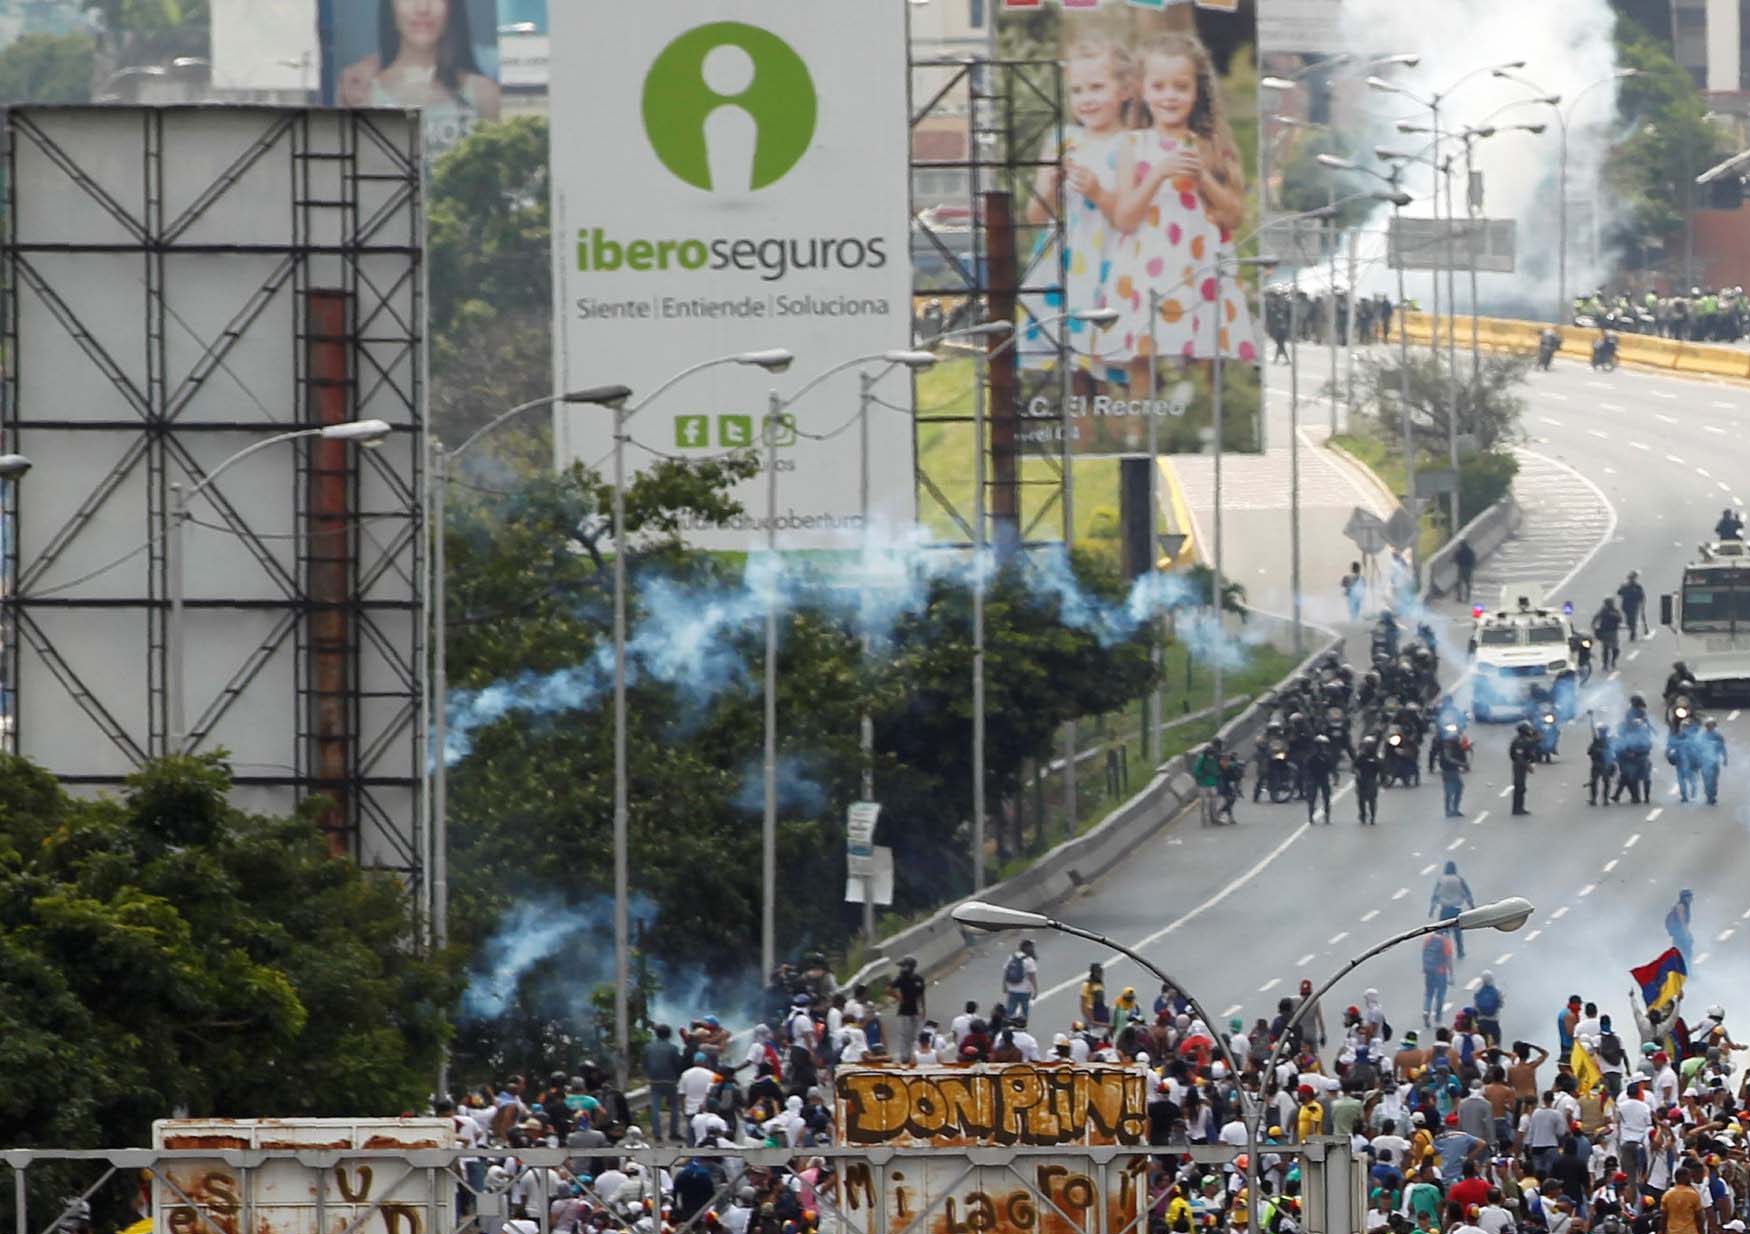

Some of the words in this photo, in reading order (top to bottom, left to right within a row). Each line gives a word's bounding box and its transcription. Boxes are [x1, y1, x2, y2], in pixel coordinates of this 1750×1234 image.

[577, 228, 887, 281] iberoseguros
[577, 298, 650, 319] Siente
[662, 296, 765, 319] Entiende
[776, 295, 889, 317] Soluciona
